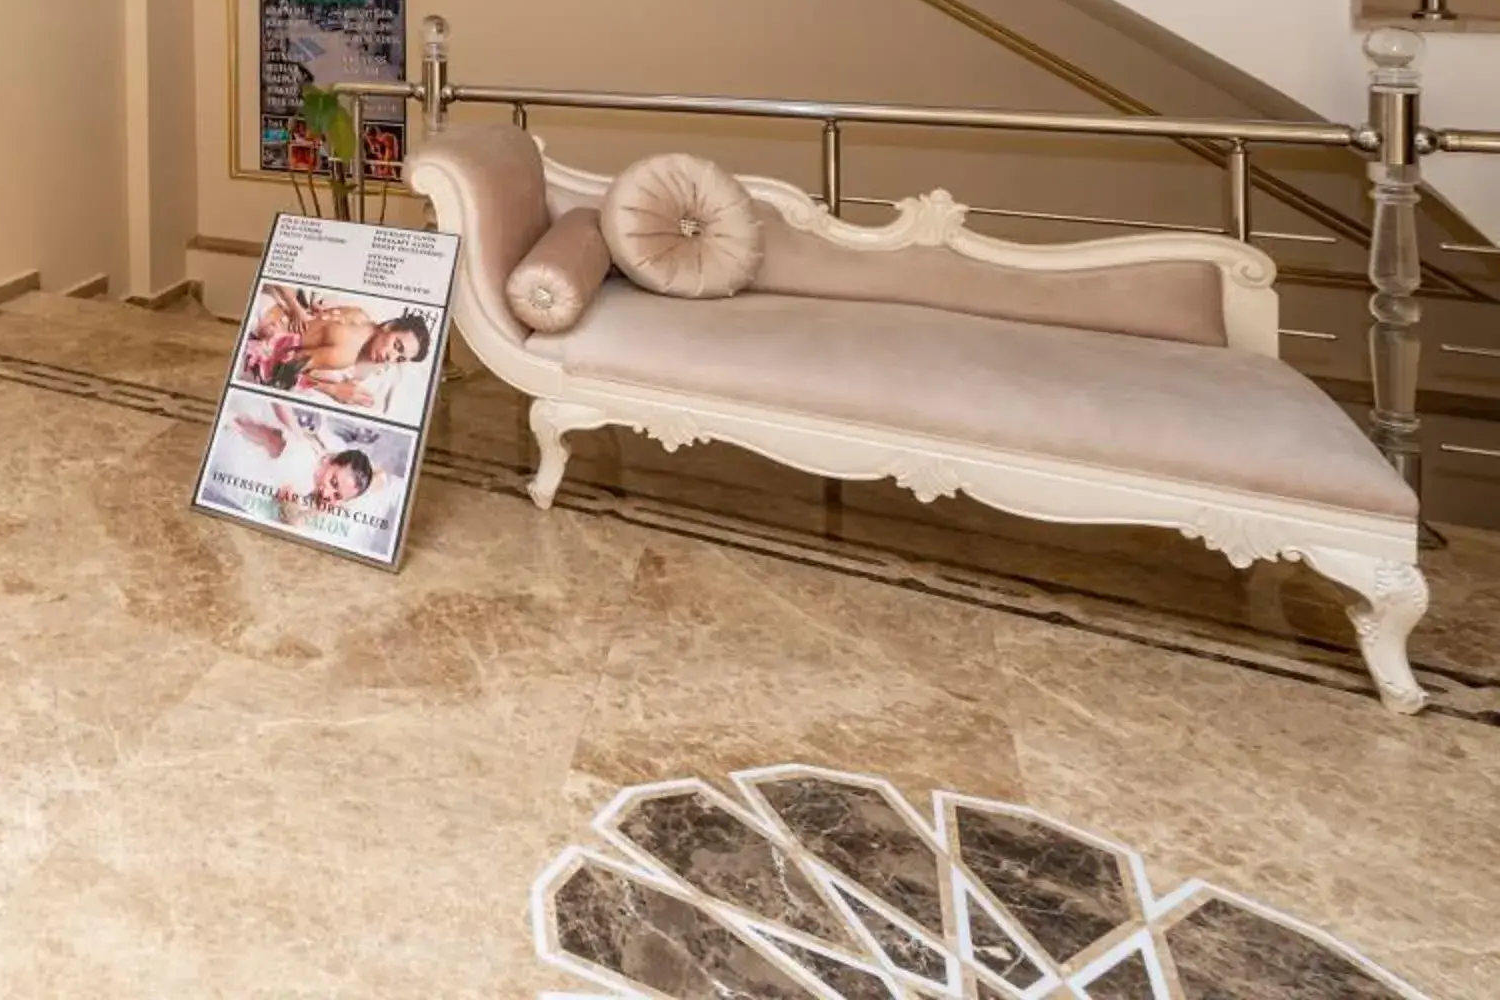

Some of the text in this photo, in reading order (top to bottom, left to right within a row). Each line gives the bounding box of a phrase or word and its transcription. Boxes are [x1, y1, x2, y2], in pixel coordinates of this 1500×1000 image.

[212, 471, 299, 504] INTERSTELLAR
[302, 493, 350, 519] SPORTS
[353, 510, 389, 531] CLUB
